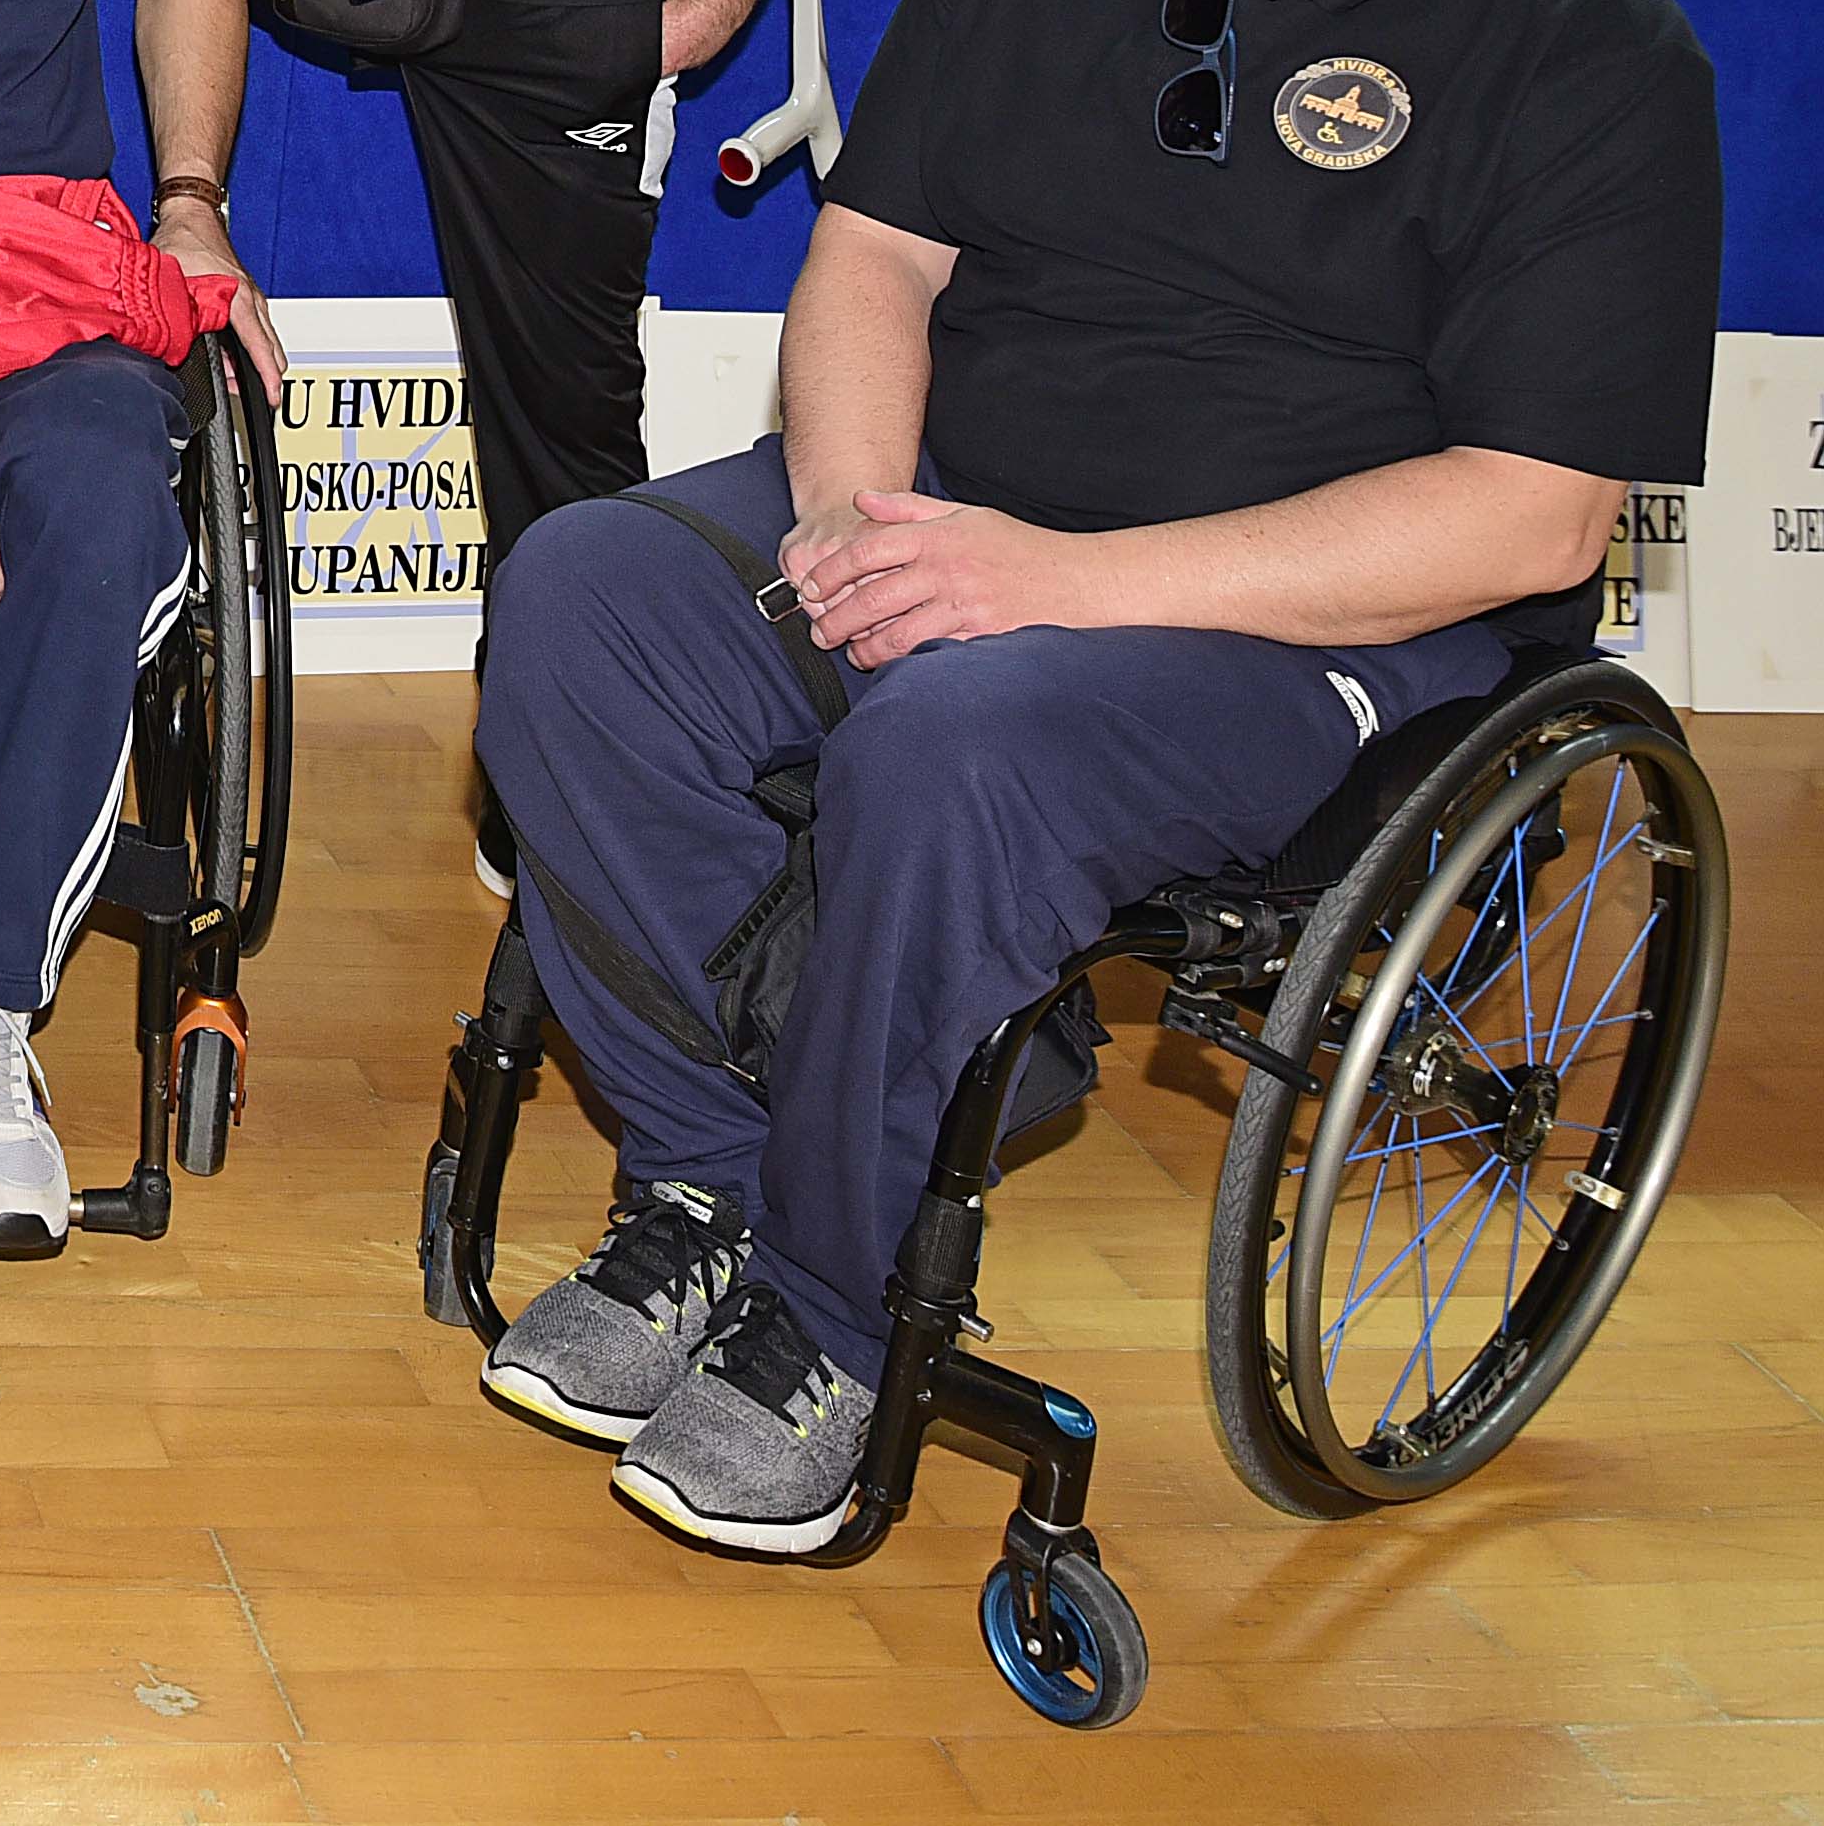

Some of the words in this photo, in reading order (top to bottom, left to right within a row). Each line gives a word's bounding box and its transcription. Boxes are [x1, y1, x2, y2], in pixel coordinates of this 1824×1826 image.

[1333, 60, 1397, 90] HVIDR-a
[1277, 113, 1301, 153] NOVA
[1302, 143, 1388, 168] GRADIŠKA
